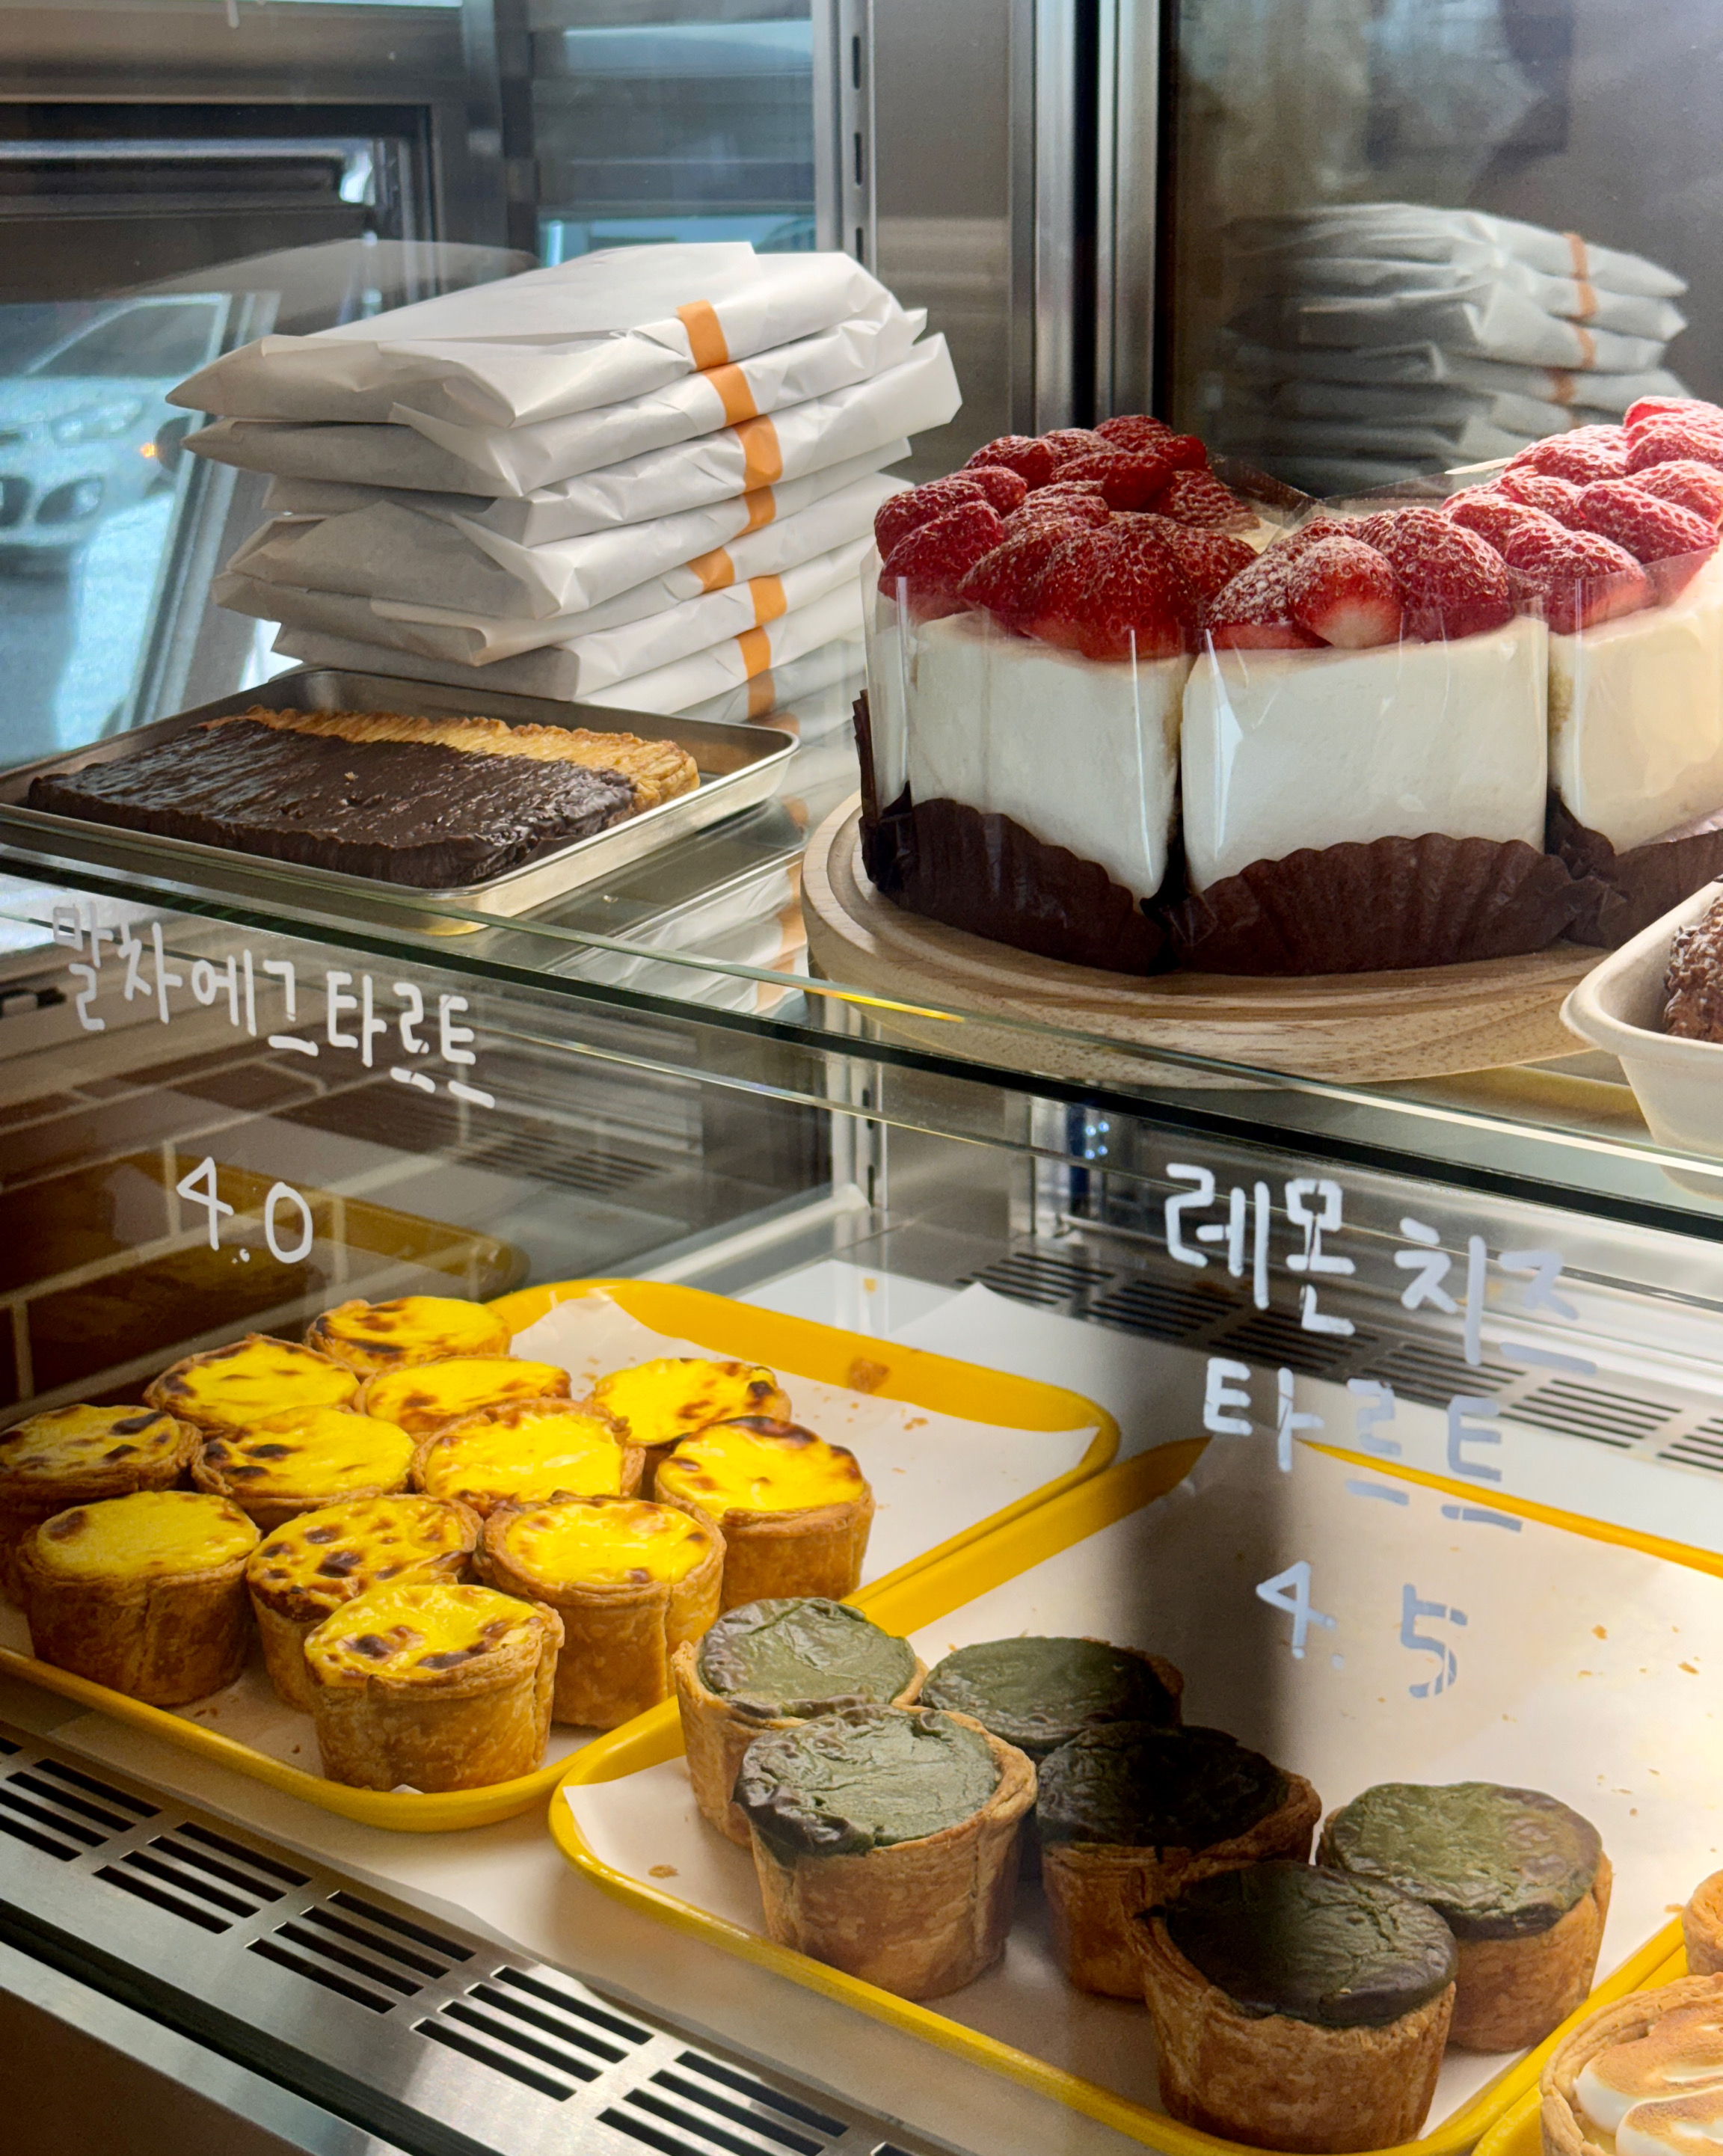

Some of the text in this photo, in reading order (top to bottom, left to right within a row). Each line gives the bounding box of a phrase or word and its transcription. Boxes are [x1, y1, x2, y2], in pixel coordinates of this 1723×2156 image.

[176, 1156, 313, 1264] 4.0
[1203, 1357, 1523, 1532] 타르트
[1256, 1560, 1468, 1698] 4.5
